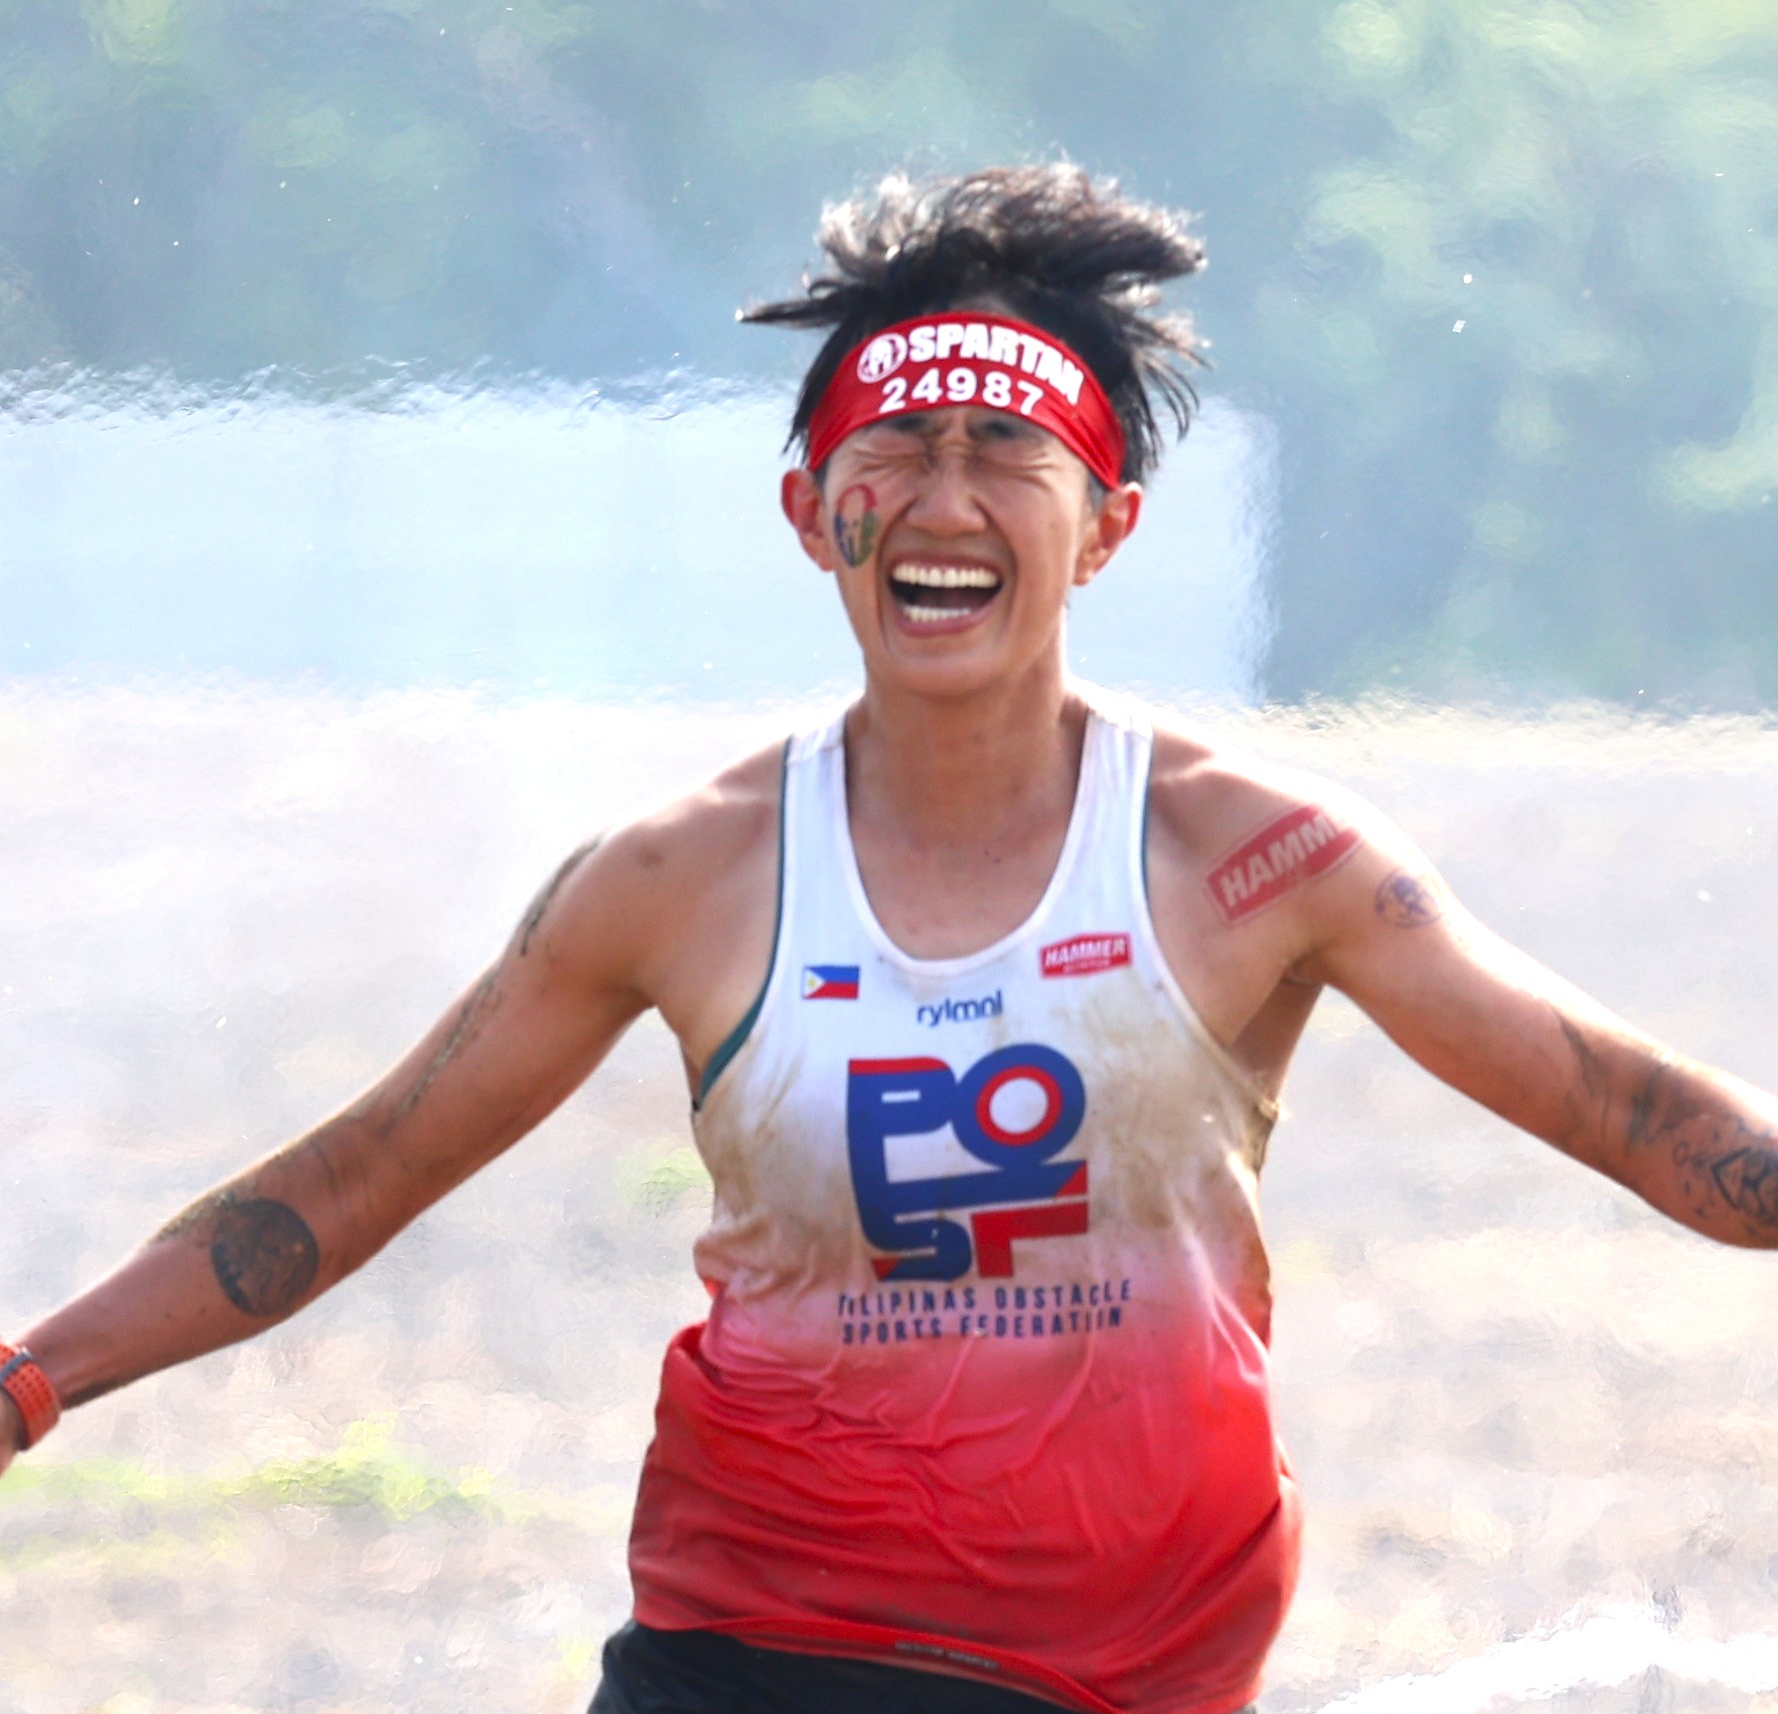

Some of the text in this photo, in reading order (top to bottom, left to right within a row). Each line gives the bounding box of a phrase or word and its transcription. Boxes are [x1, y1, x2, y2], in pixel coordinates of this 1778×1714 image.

[908, 323, 1084, 405] SPARTAN
[878, 367, 1043, 415] 24987
[1045, 939, 1127, 967] HAMMER
[994, 1278, 1130, 1309] OBSTACLE
[843, 1316, 942, 1345] SPORTS
